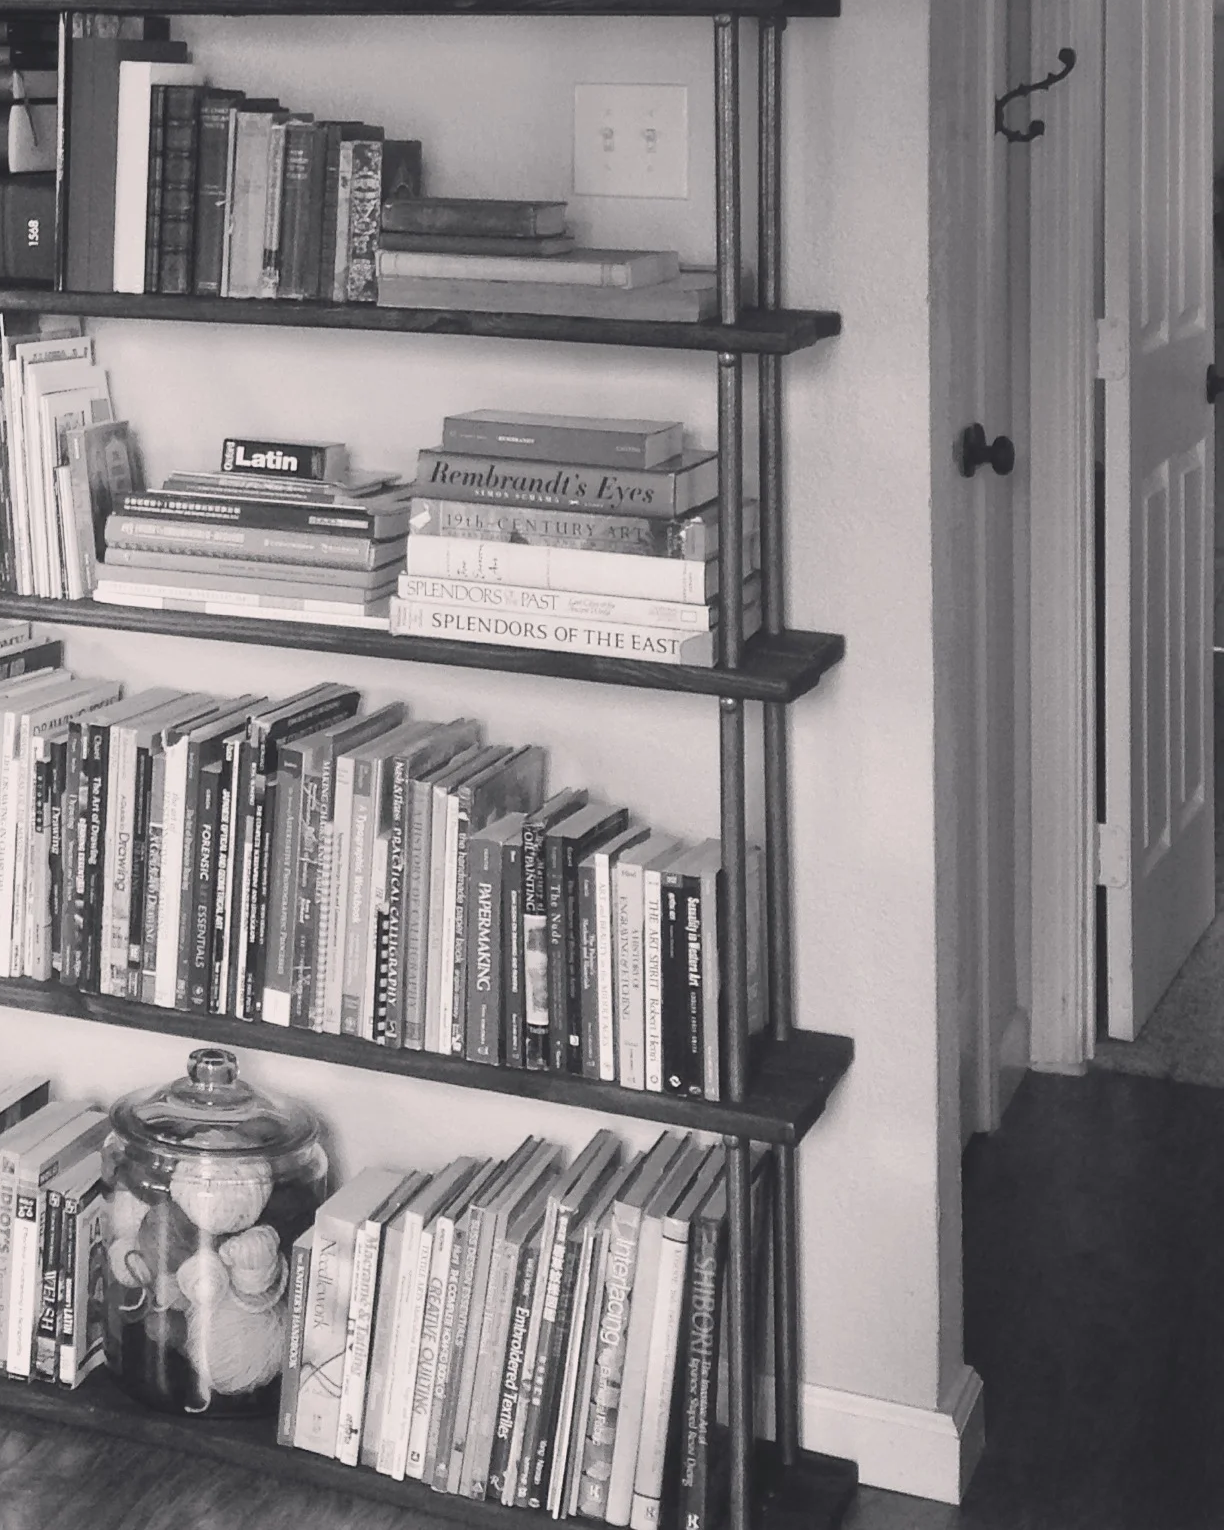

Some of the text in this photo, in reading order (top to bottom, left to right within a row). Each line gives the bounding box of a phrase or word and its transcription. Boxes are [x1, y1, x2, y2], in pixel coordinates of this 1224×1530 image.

[27, 218, 40, 247] 1568
[235, 445, 298, 472] Latin
[428, 460, 655, 509] Rembrandt's Eyes
[407, 580, 503, 605] SPLENDORS
[521, 594, 559, 611] PAST
[431, 613, 680, 655] SPLENDORS OF THE EAST
[115, 831, 130, 892] Drawing
[524, 855, 537, 911] PAINTING
[195, 823, 212, 969] FORENSIC ESSENTIALS
[352, 876, 364, 924] Workbook
[387, 827, 401, 1007] PRACTICAL CALLIGRAPHY
[550, 884, 561, 945] The Nude
[685, 897, 700, 932] Sexuality
[476, 882, 492, 991] PAPERMAKING
[648, 899, 659, 1062] THE ART SPIRIT Robert Henri
[40, 1270, 56, 1332] WELSH
[312, 1236, 337, 1329] Needlework
[600, 1236, 635, 1346] Interlacing
[690, 1253, 716, 1356] SHIBORI
[414, 1277, 443, 1416] CREATIVE QUILTING
[497, 1306, 529, 1440] Embroidered Textiles
